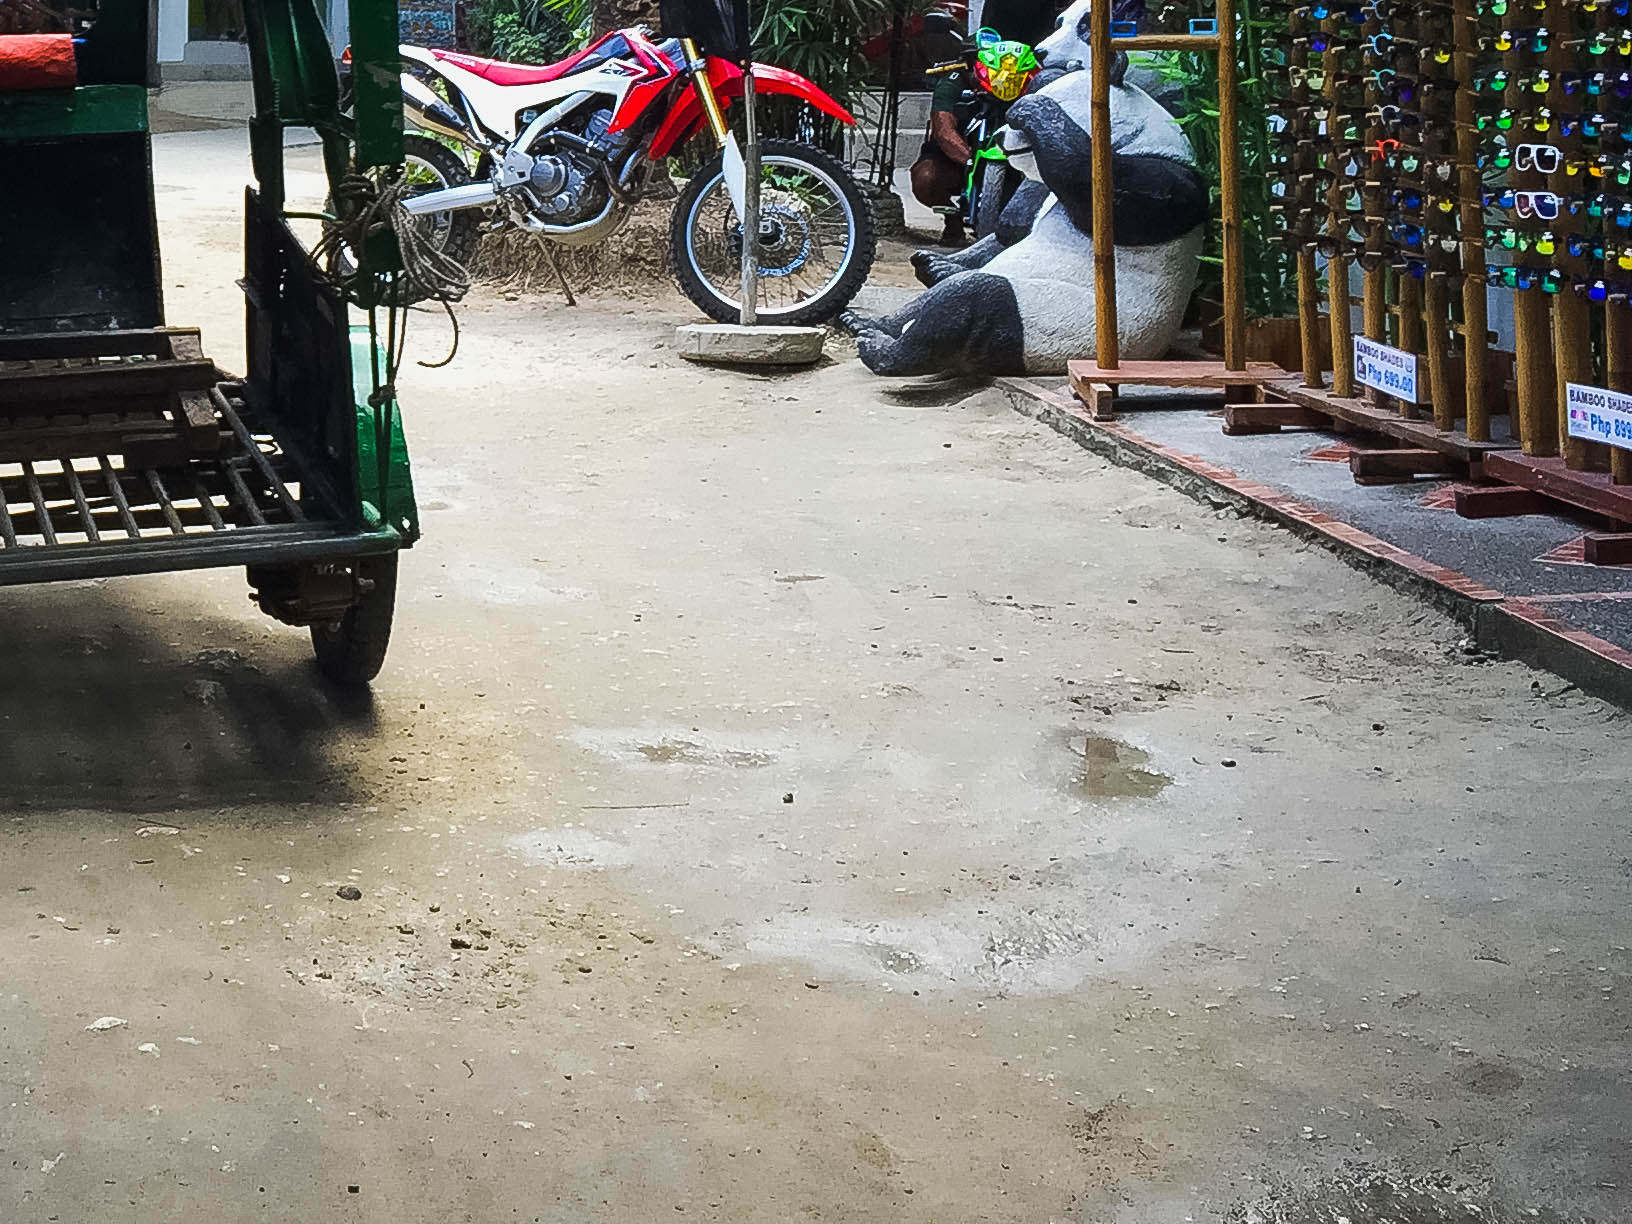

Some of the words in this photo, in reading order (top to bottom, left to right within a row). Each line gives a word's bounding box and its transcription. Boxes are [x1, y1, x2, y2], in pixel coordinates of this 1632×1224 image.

[1368, 363, 1382, 385] Php
[1569, 389, 1606, 408] BAMBOO
[1590, 413, 1611, 438] Php
